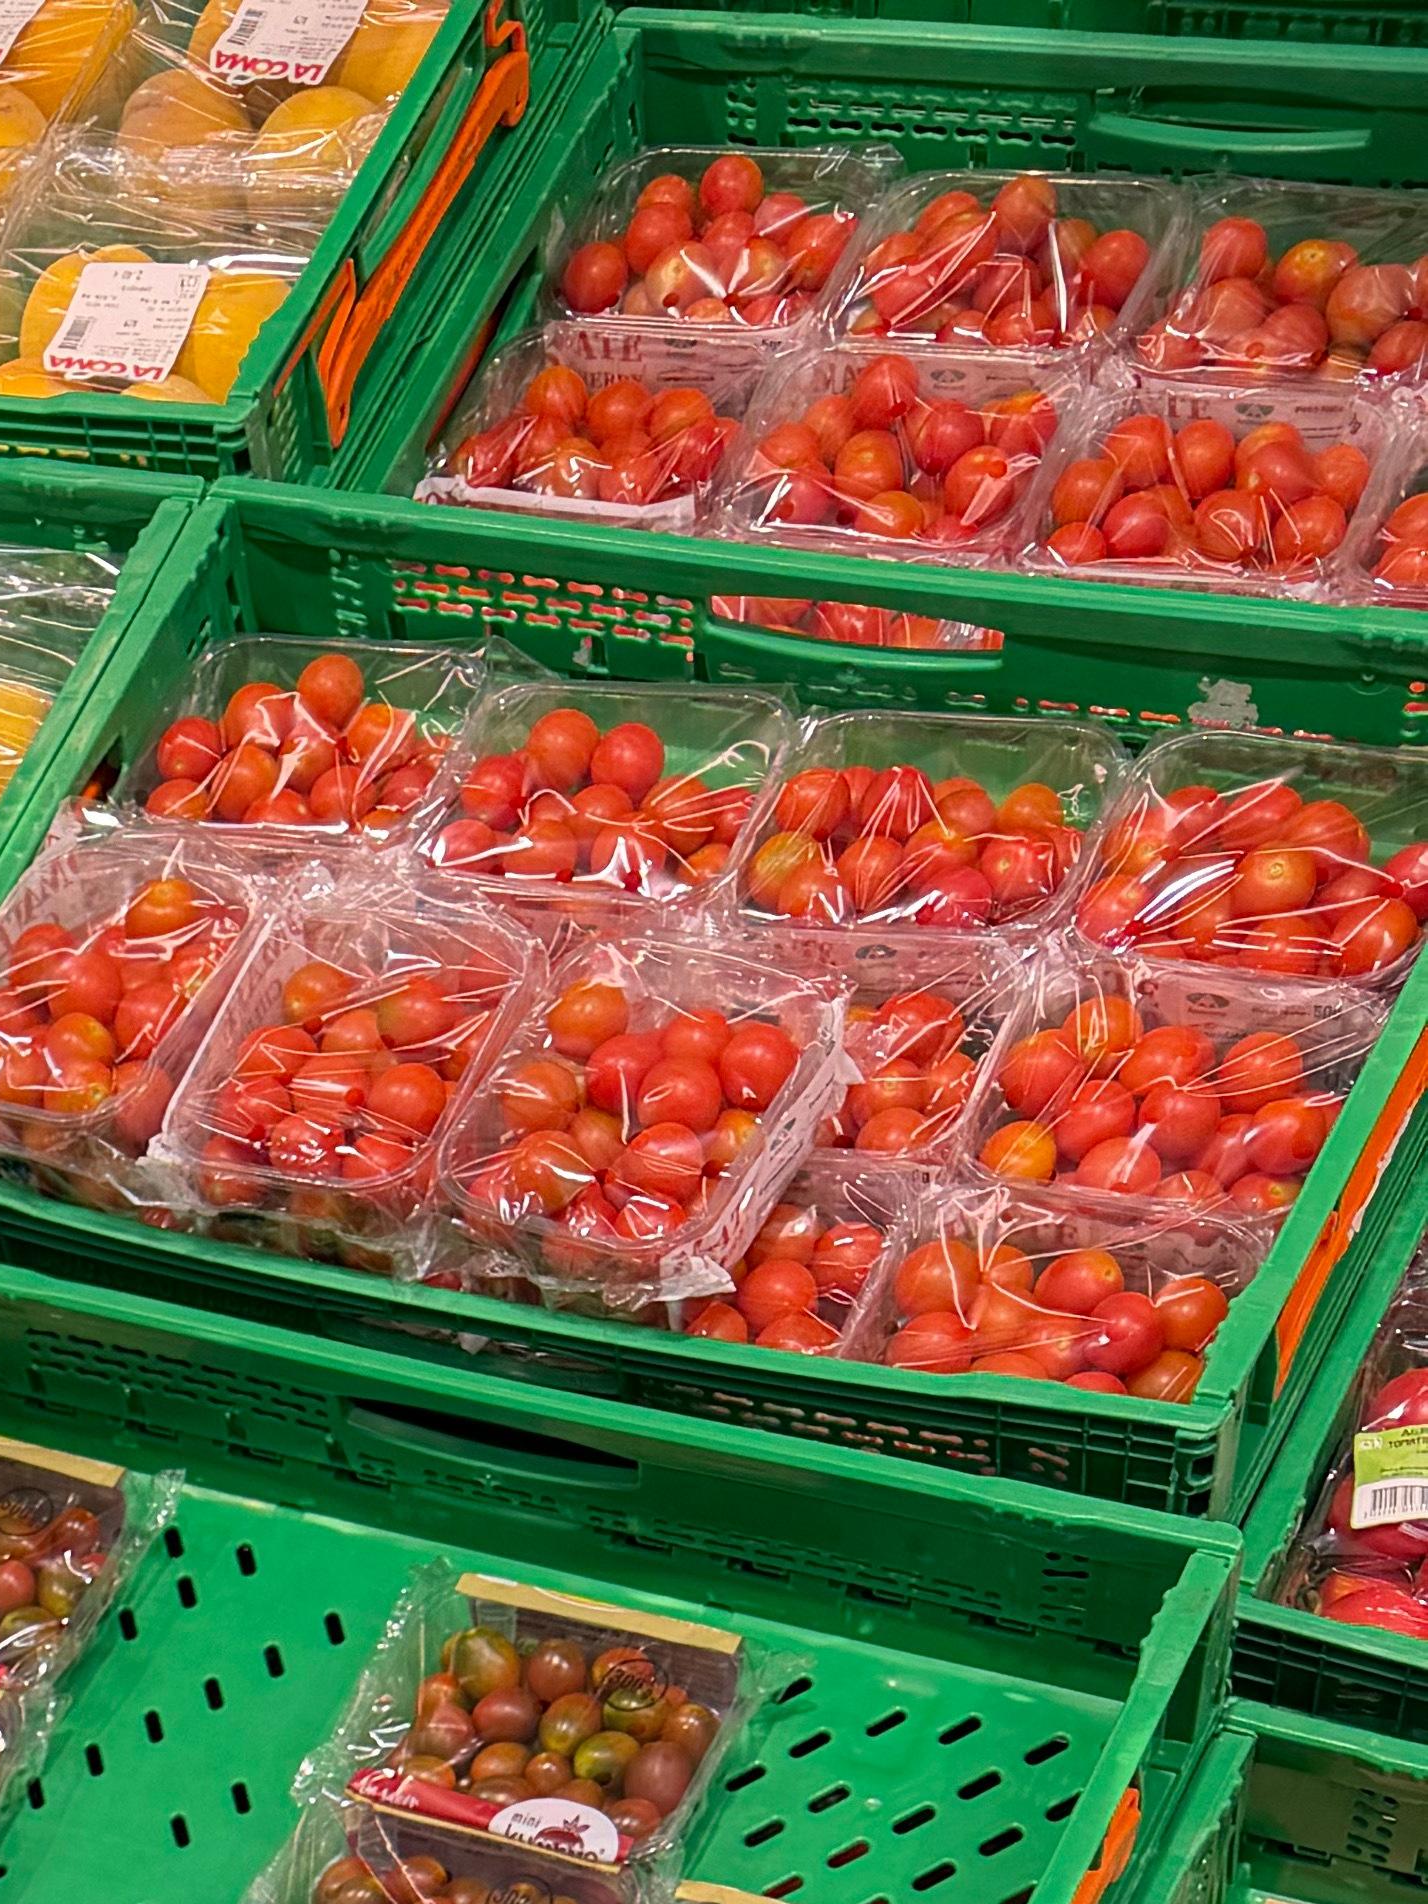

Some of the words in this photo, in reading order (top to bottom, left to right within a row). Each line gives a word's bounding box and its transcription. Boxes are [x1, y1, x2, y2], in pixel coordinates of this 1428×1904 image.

[213, 48, 290, 80] COMA
[294, 62, 326, 83] LA
[49, 354, 127, 375] COMA
[132, 364, 164, 381] LA
